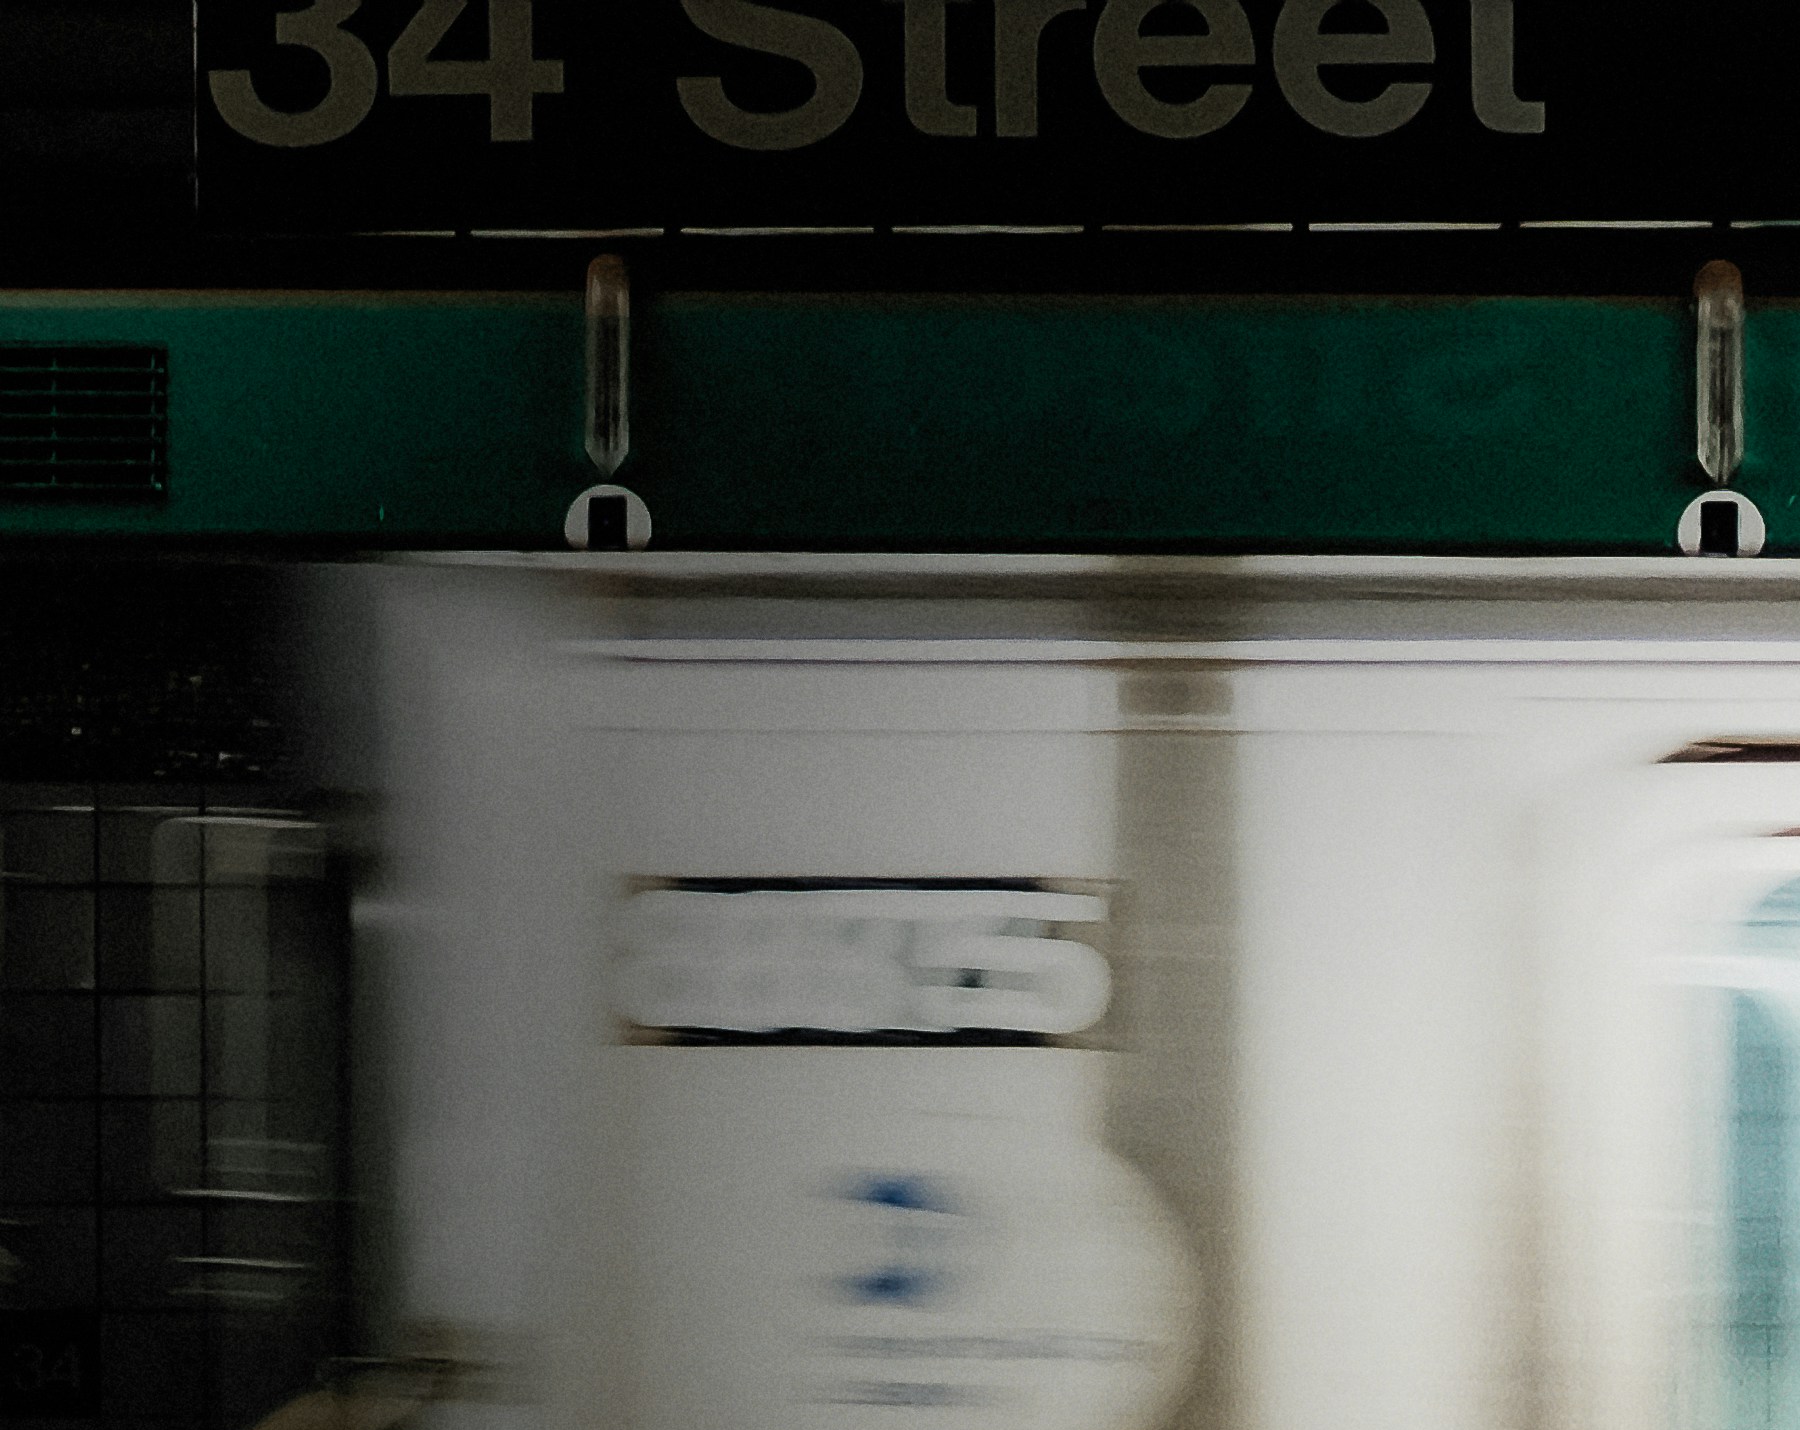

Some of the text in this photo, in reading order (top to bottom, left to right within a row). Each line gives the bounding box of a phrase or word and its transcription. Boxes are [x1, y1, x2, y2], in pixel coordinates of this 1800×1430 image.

[207, 0, 1547, 151] 34 Street
[12, 1342, 81, 1391] 34
